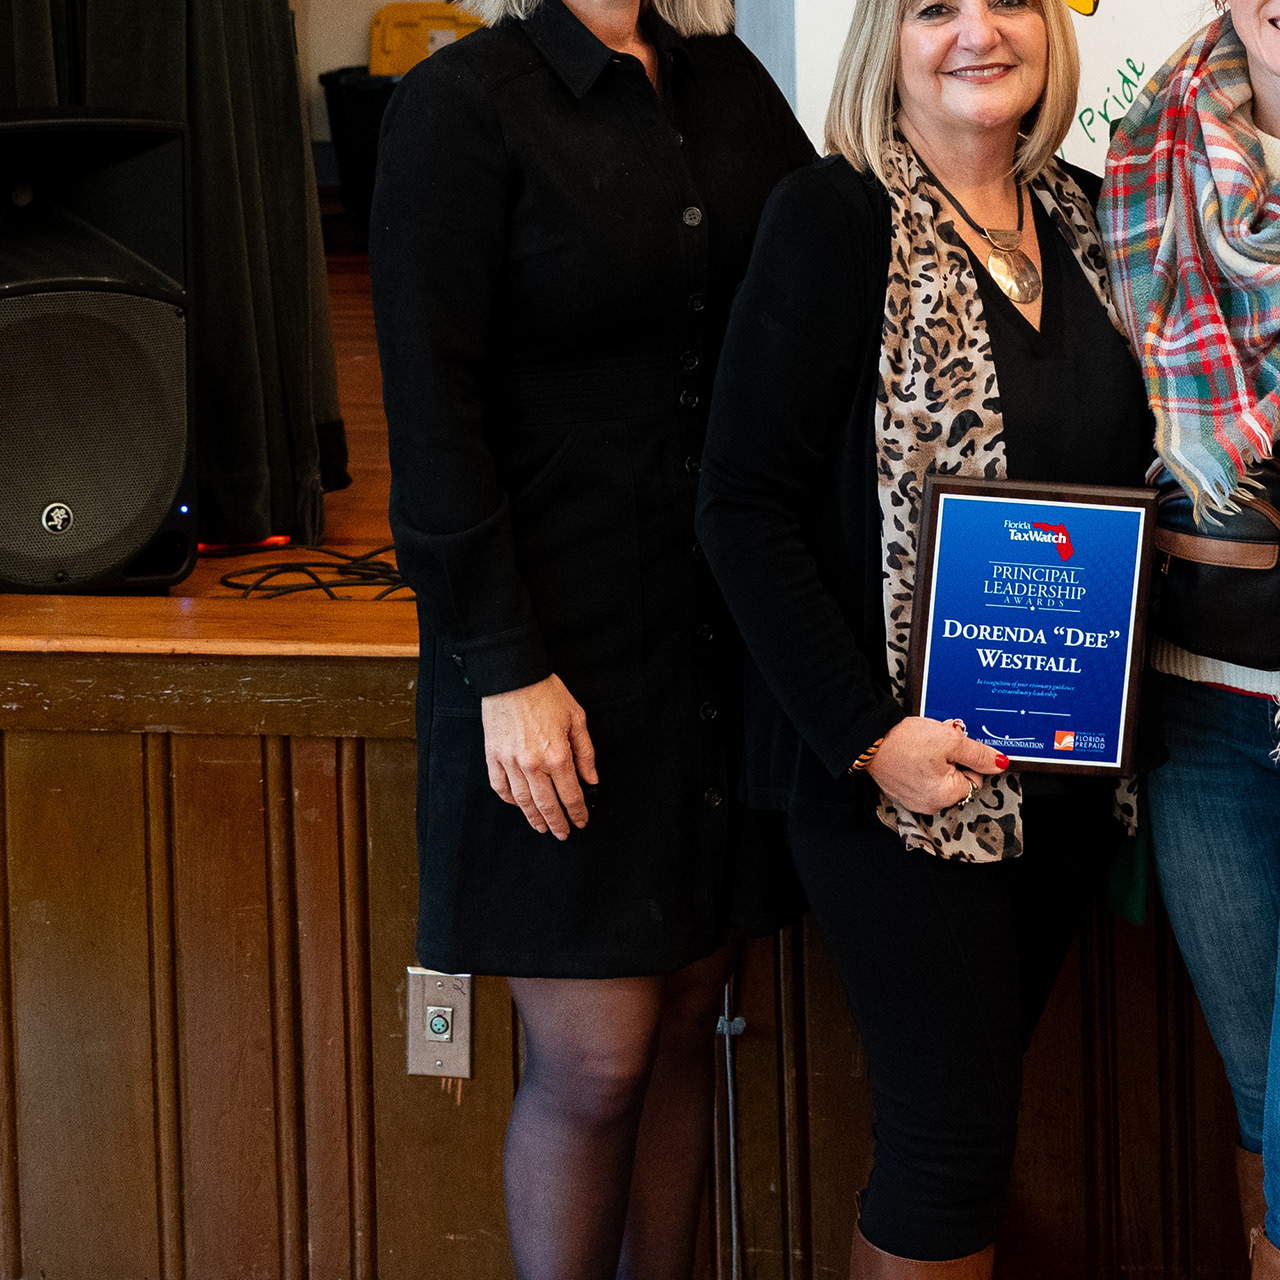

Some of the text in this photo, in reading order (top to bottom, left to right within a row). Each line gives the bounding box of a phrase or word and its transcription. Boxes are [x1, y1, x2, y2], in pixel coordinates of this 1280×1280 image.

[1078, 58, 1145, 143] Pride
[1004, 520, 1031, 530] Florida
[1009, 529, 1067, 544] TaxWatch
[993, 565, 1079, 584] PRINCIPAL
[984, 580, 1086, 600] LEADERSHIP
[1004, 596, 1064, 607] AWARDS
[1004, 740, 1044, 749] FOUNDATION
[1075, 735, 1105, 743] FLORIDA
